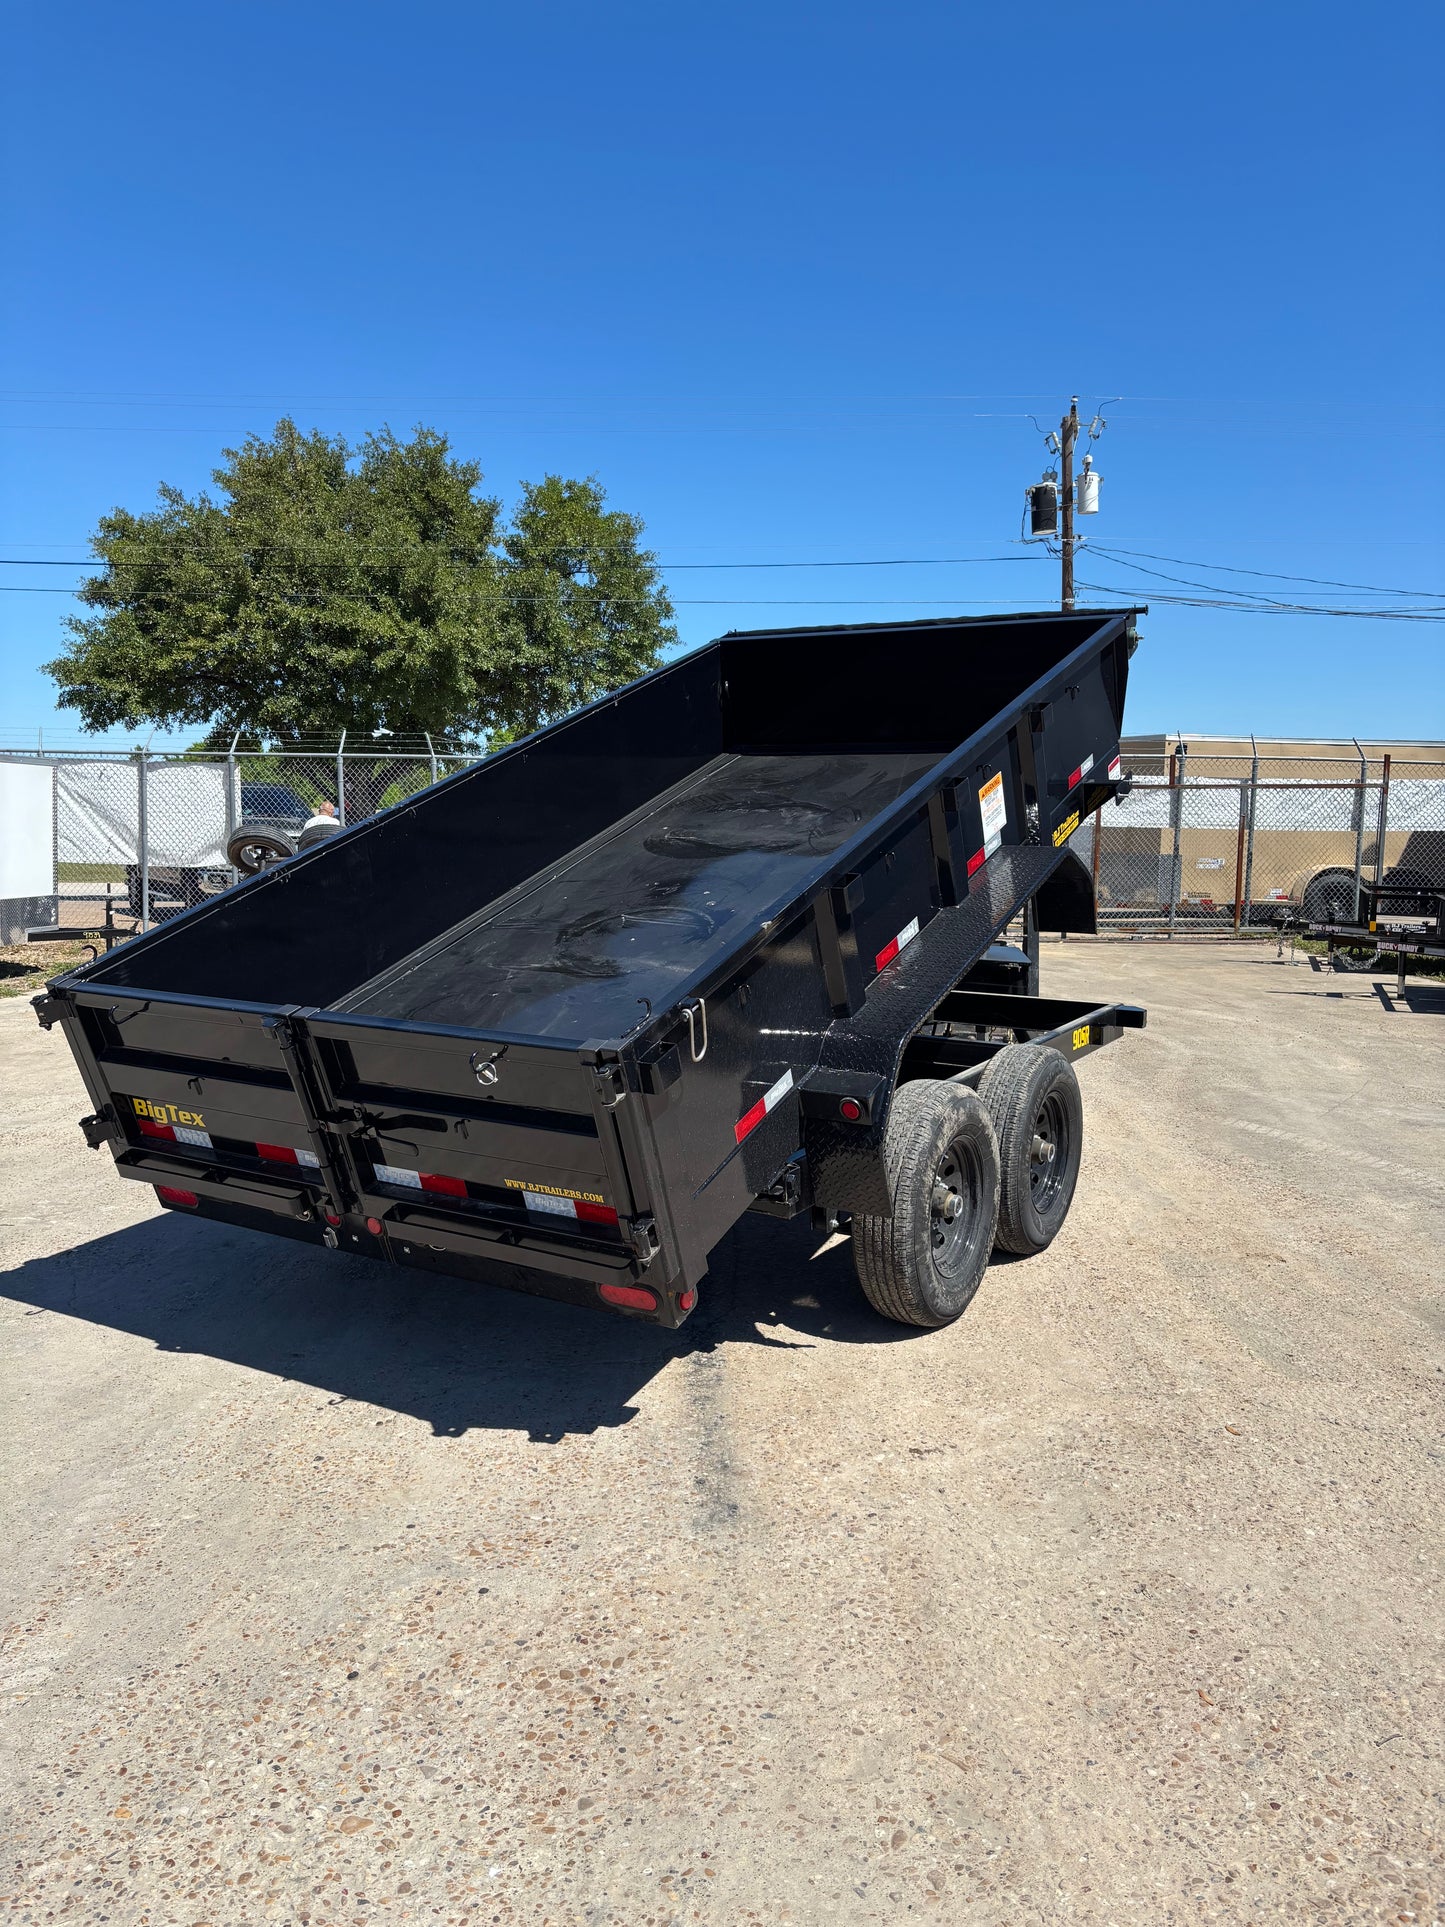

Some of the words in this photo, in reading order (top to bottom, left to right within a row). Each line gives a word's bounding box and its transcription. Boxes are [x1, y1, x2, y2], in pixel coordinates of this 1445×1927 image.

[1376, 941, 1394, 951] BUCK
[1397, 943, 1419, 953] DANDY
[132, 1098, 206, 1128] BigTex
[504, 1178, 605, 1204] WWW.RJTRAILERS.COM
